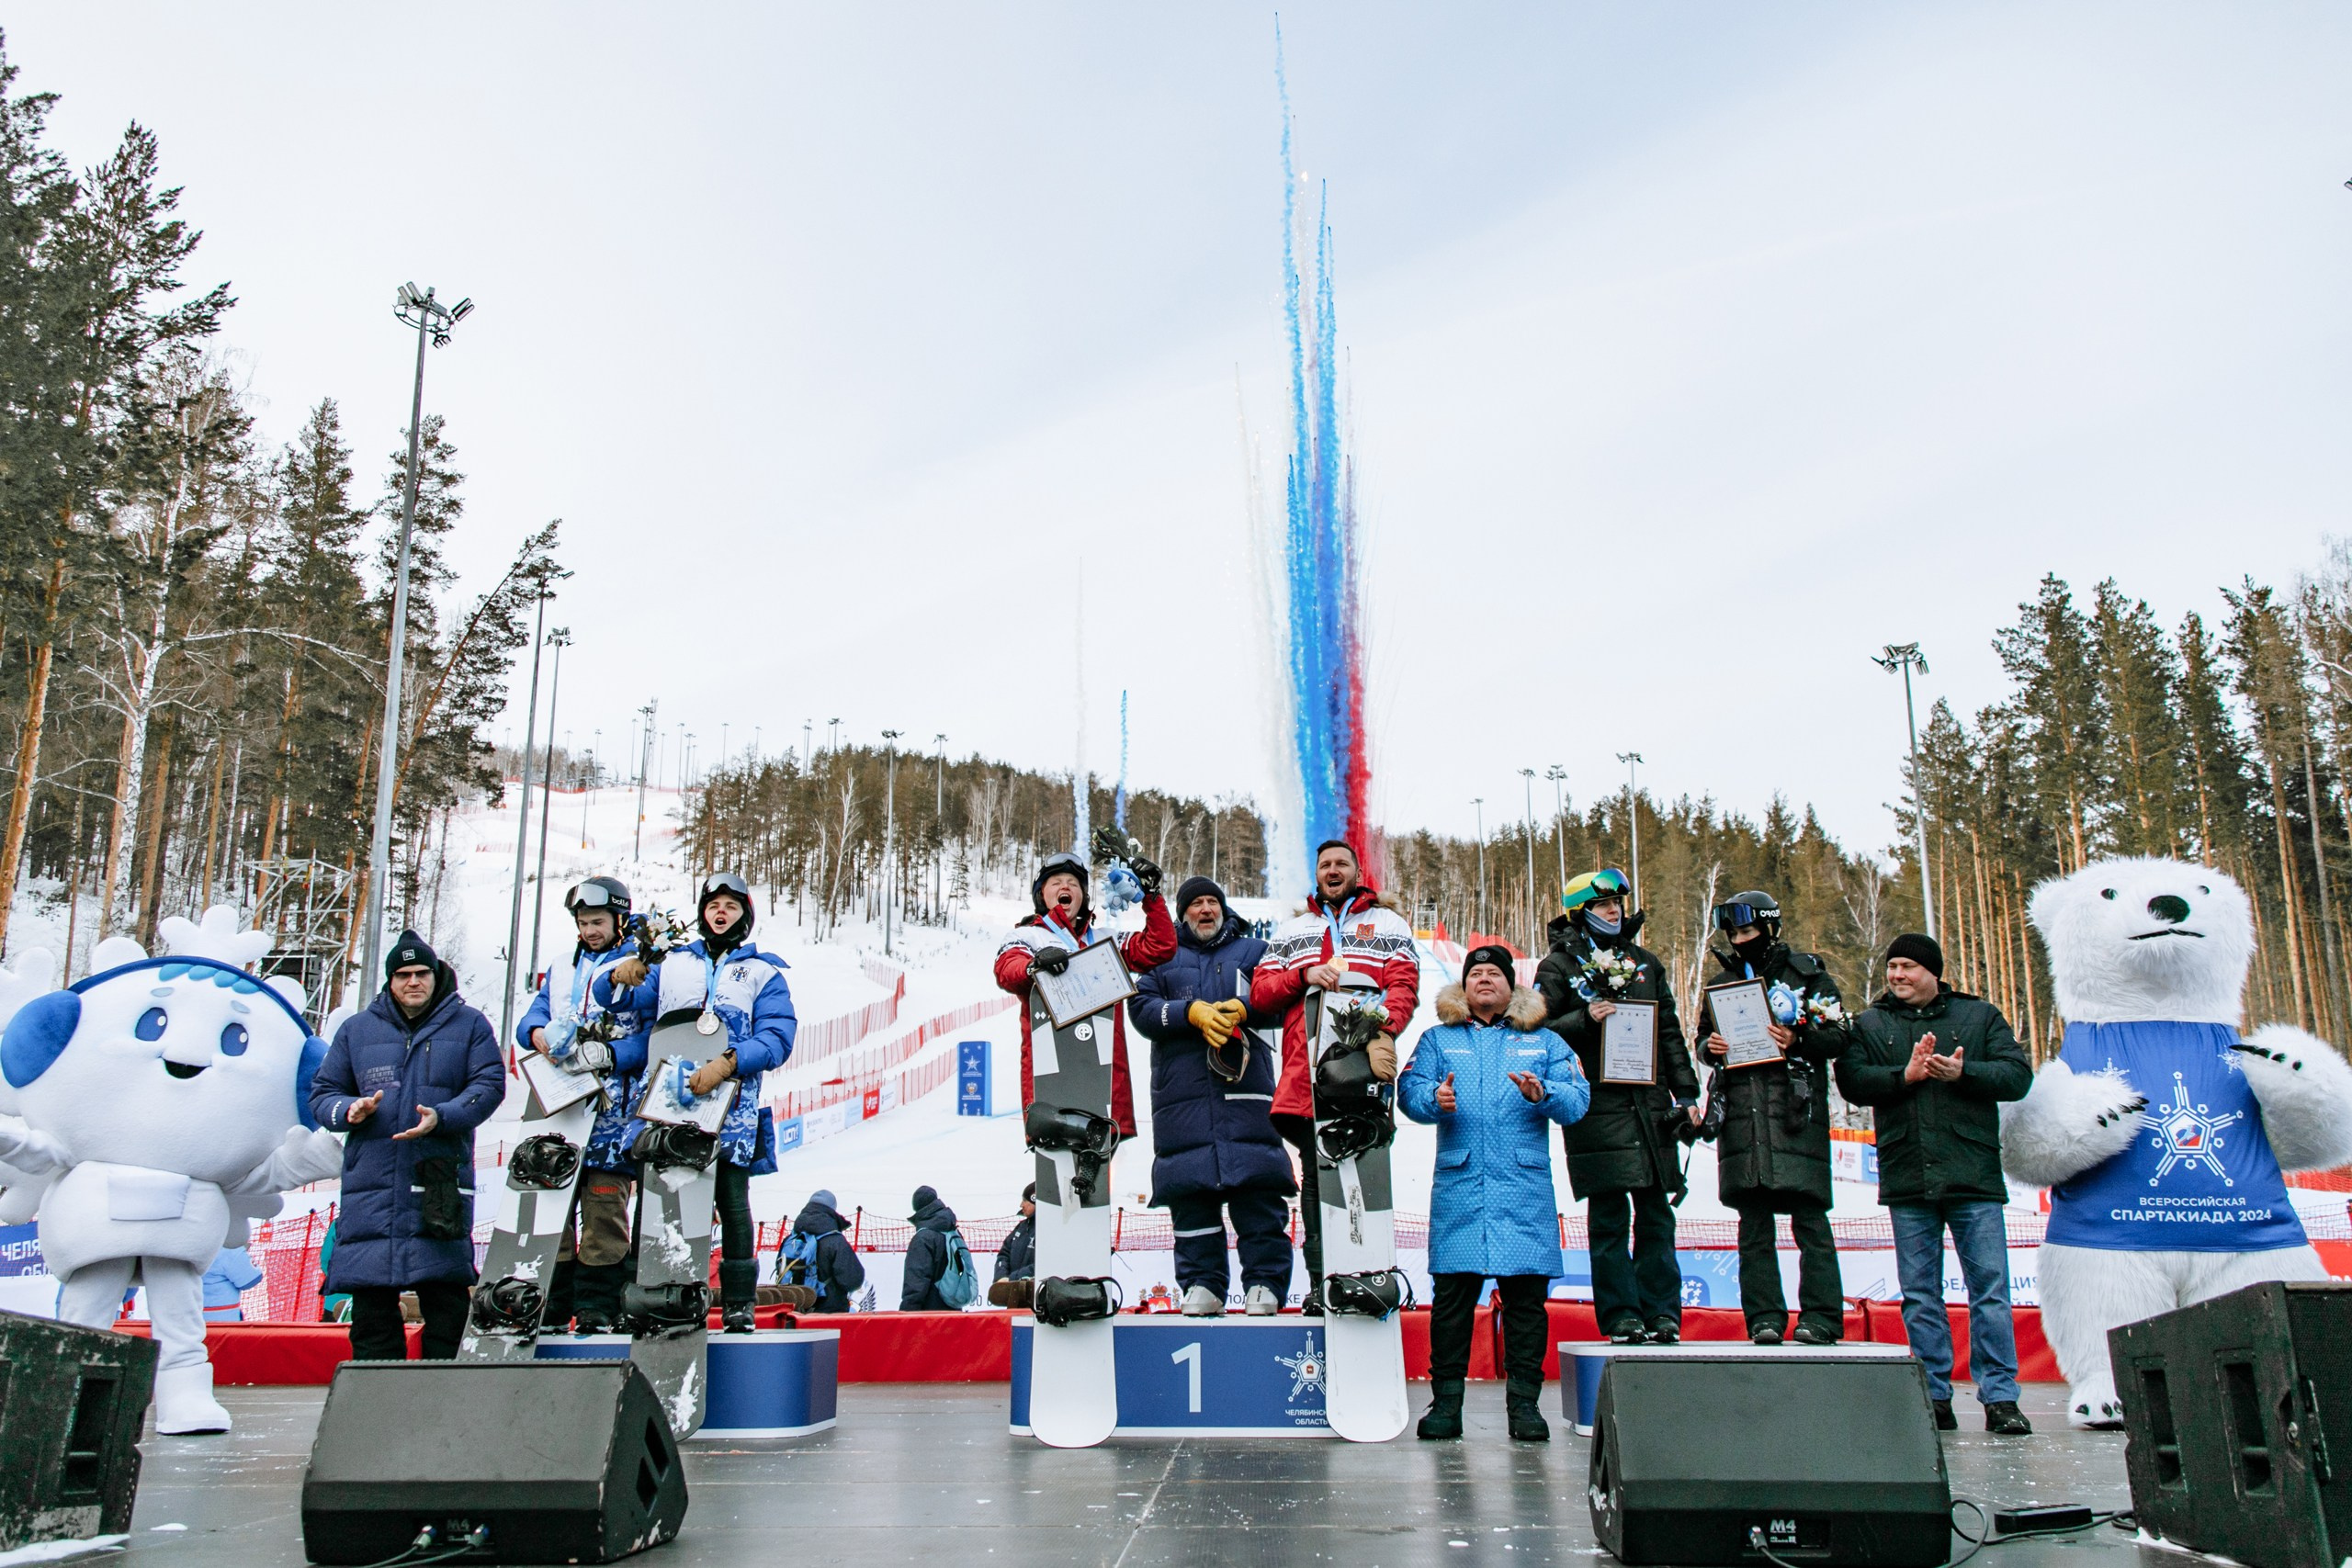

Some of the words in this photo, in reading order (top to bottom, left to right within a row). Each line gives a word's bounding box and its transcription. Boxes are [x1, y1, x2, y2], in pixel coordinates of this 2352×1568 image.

[2139, 1196, 2246, 1207] ВСЕРОССИЙСКАЯ
[2110, 1209, 2235, 1224] СПАРТАКИАДА
[2237, 1209, 2272, 1222] 2024
[1171, 1342, 1202, 1413] 1
[1295, 1417, 1329, 1426] ОБЛАСТЬ
[1770, 1519, 1796, 1533] M4
